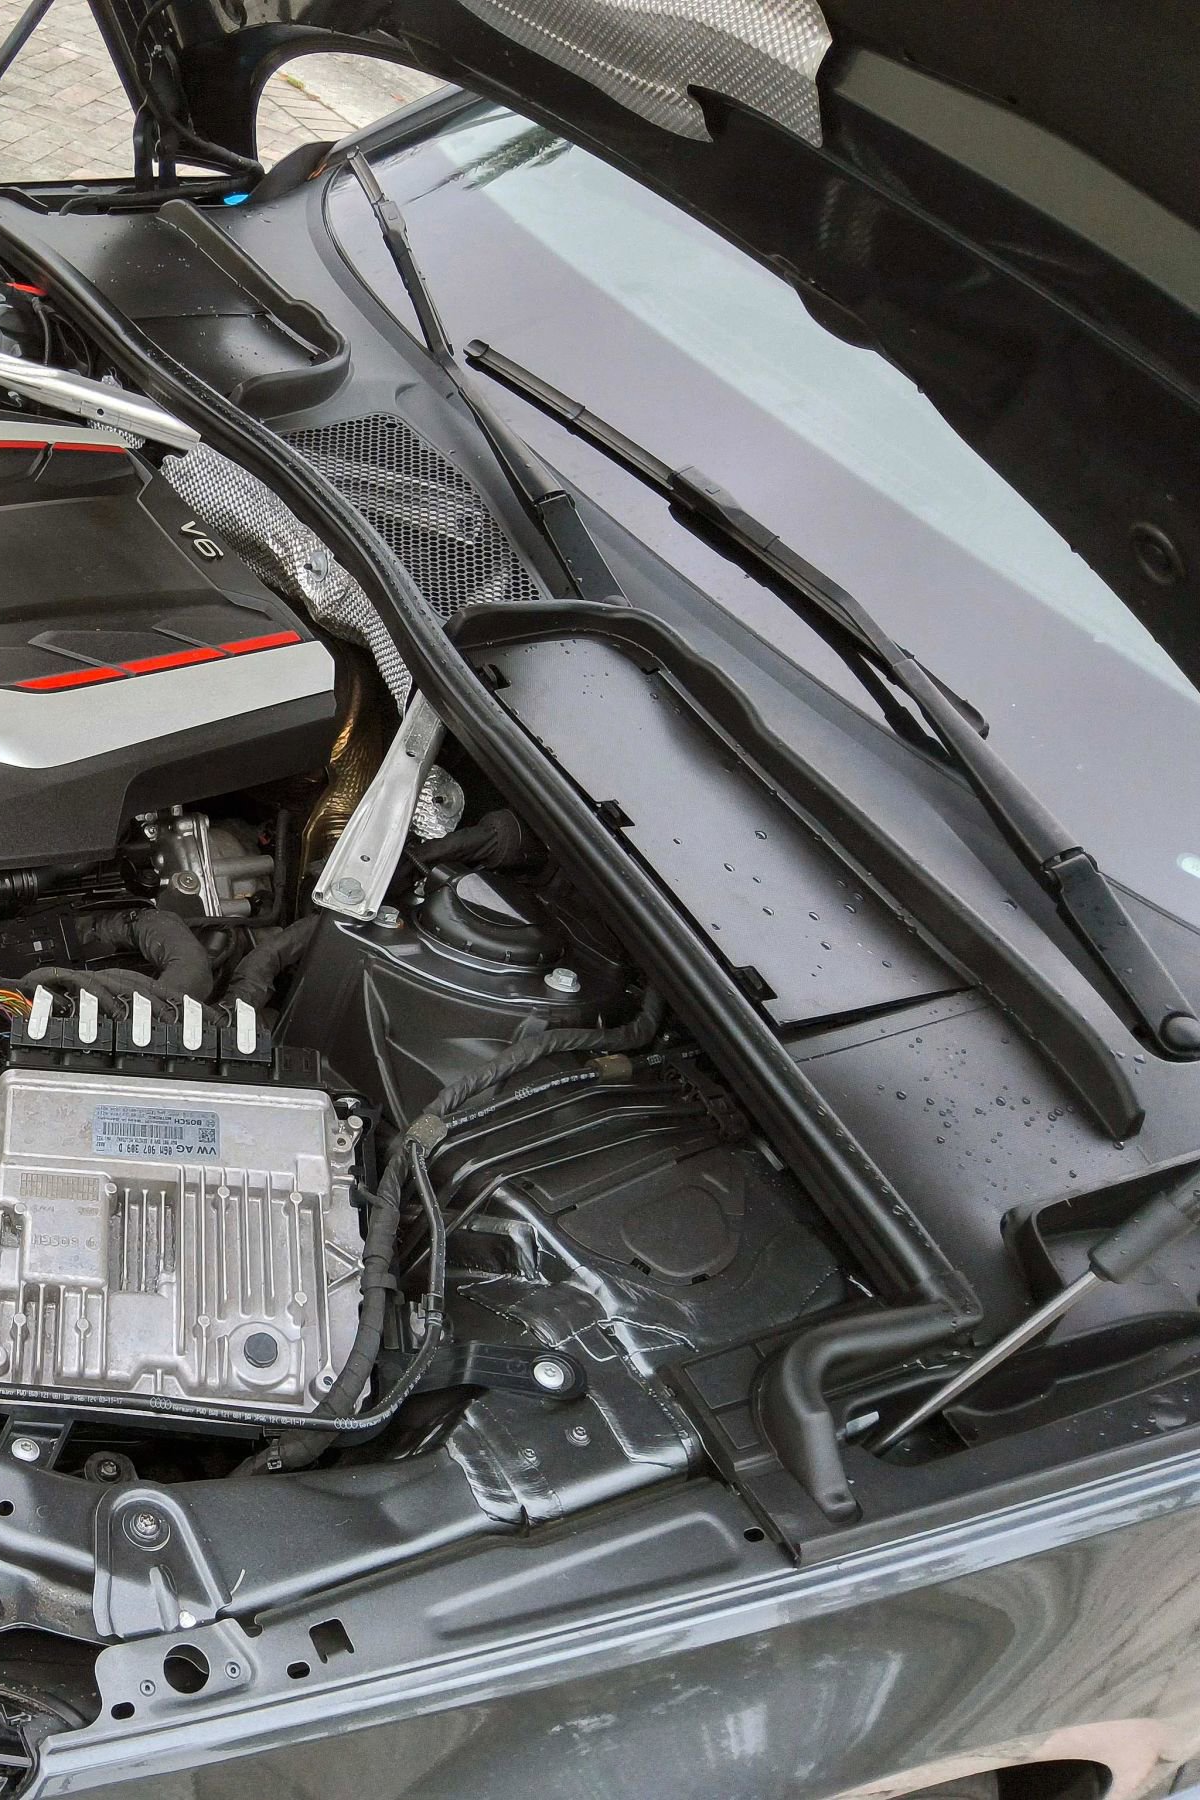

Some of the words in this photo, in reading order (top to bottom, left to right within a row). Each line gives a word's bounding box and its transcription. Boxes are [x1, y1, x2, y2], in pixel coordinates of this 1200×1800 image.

[181, 520, 224, 557] V6
[174, 1118, 202, 1126] BOSCH
[176, 1144, 194, 1153] AG
[196, 1146, 217, 1155] VW
